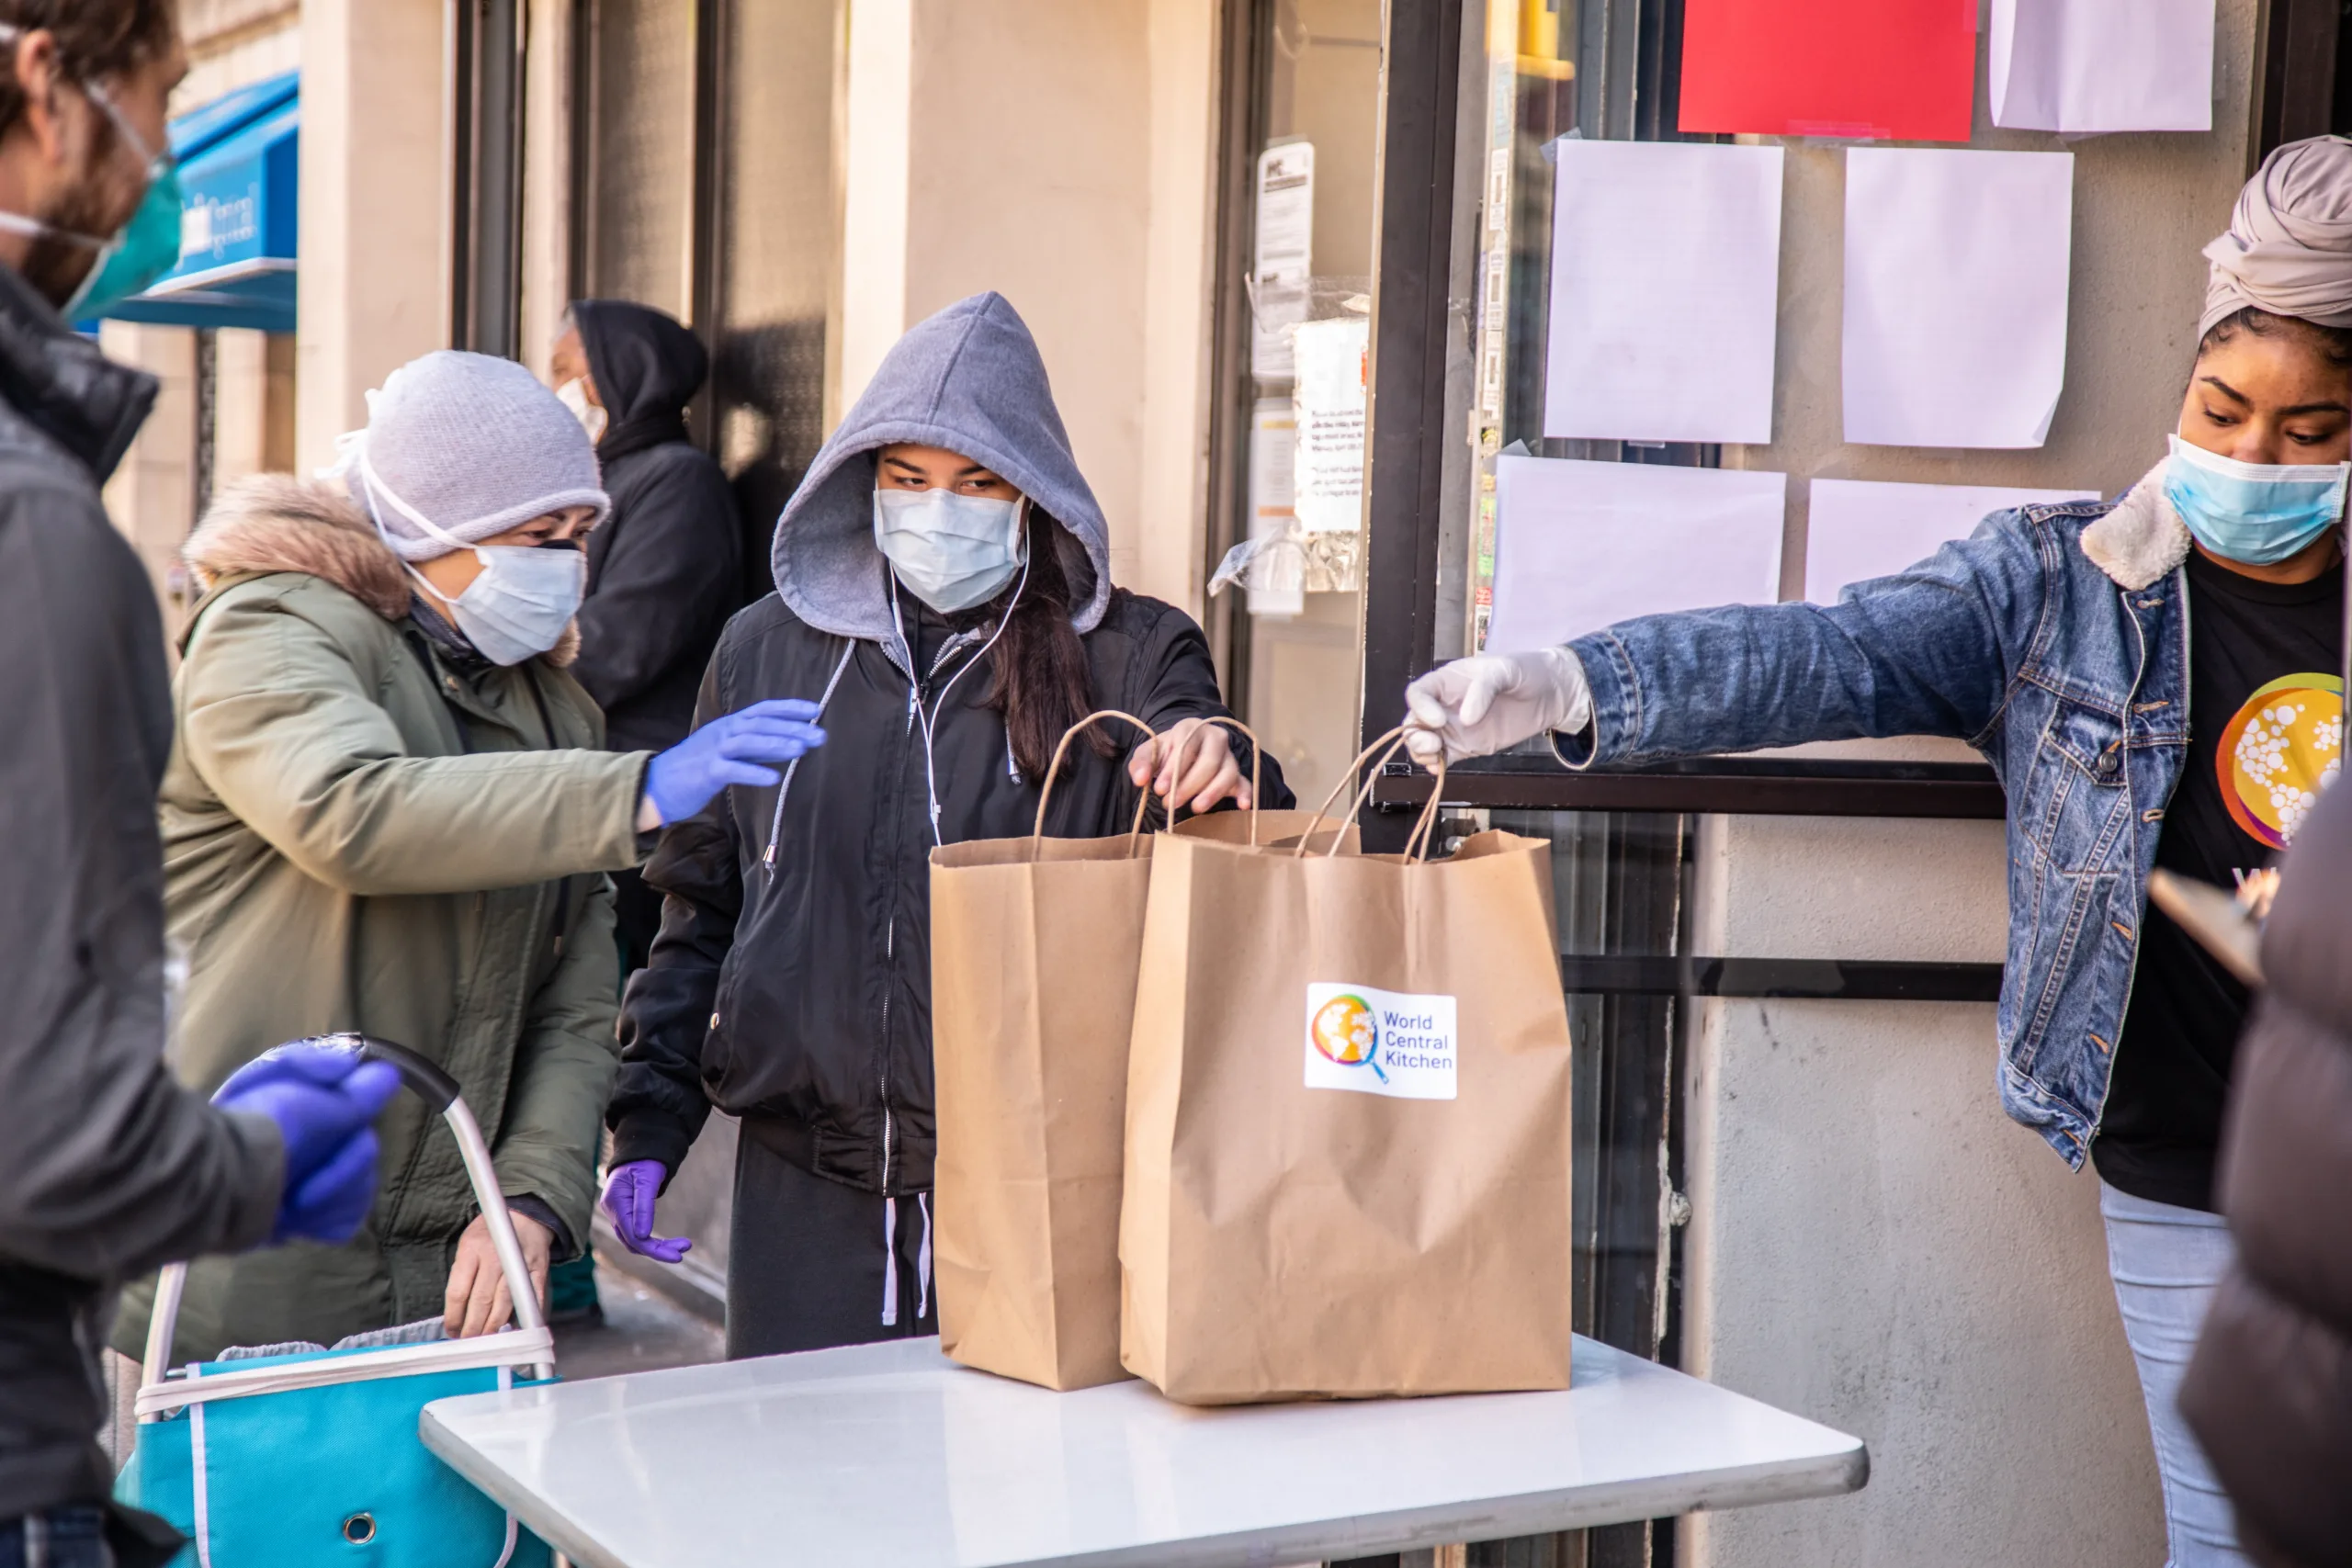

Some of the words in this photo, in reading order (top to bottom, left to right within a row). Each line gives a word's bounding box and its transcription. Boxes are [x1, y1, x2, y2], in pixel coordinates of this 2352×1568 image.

[1384, 1010, 1432, 1030] World
[1385, 1031, 1448, 1050] Central
[1385, 1050, 1453, 1069] Kitchen
